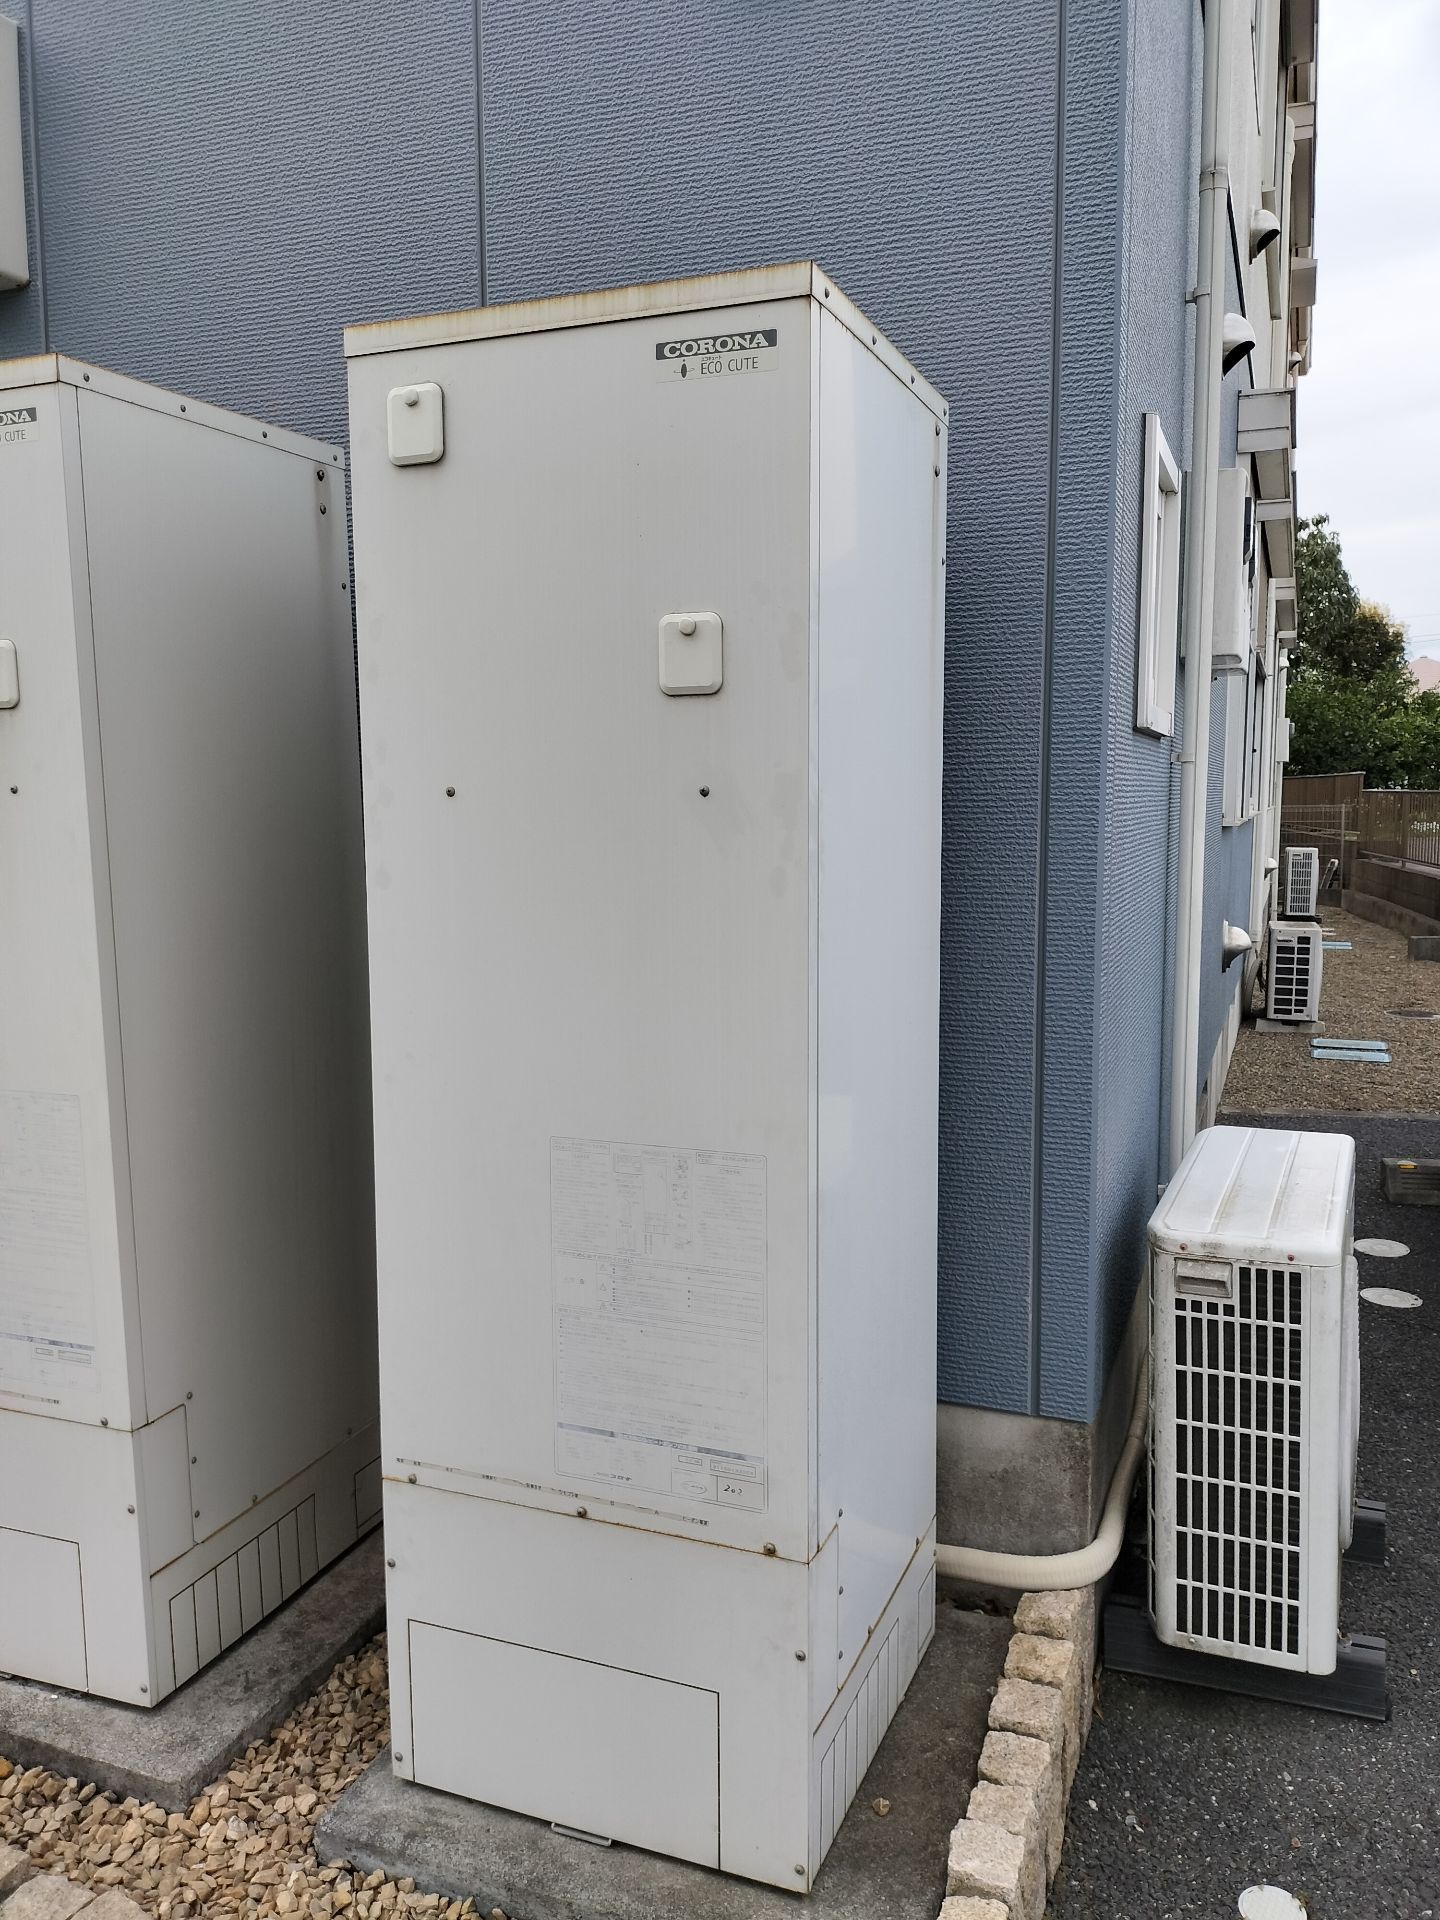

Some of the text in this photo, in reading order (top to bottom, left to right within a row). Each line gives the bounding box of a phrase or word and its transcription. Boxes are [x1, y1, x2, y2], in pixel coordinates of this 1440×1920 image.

[662, 333, 769, 358] CORONA
[700, 356, 759, 375] ECO CUTE
[4, 429, 27, 442] CUTE
